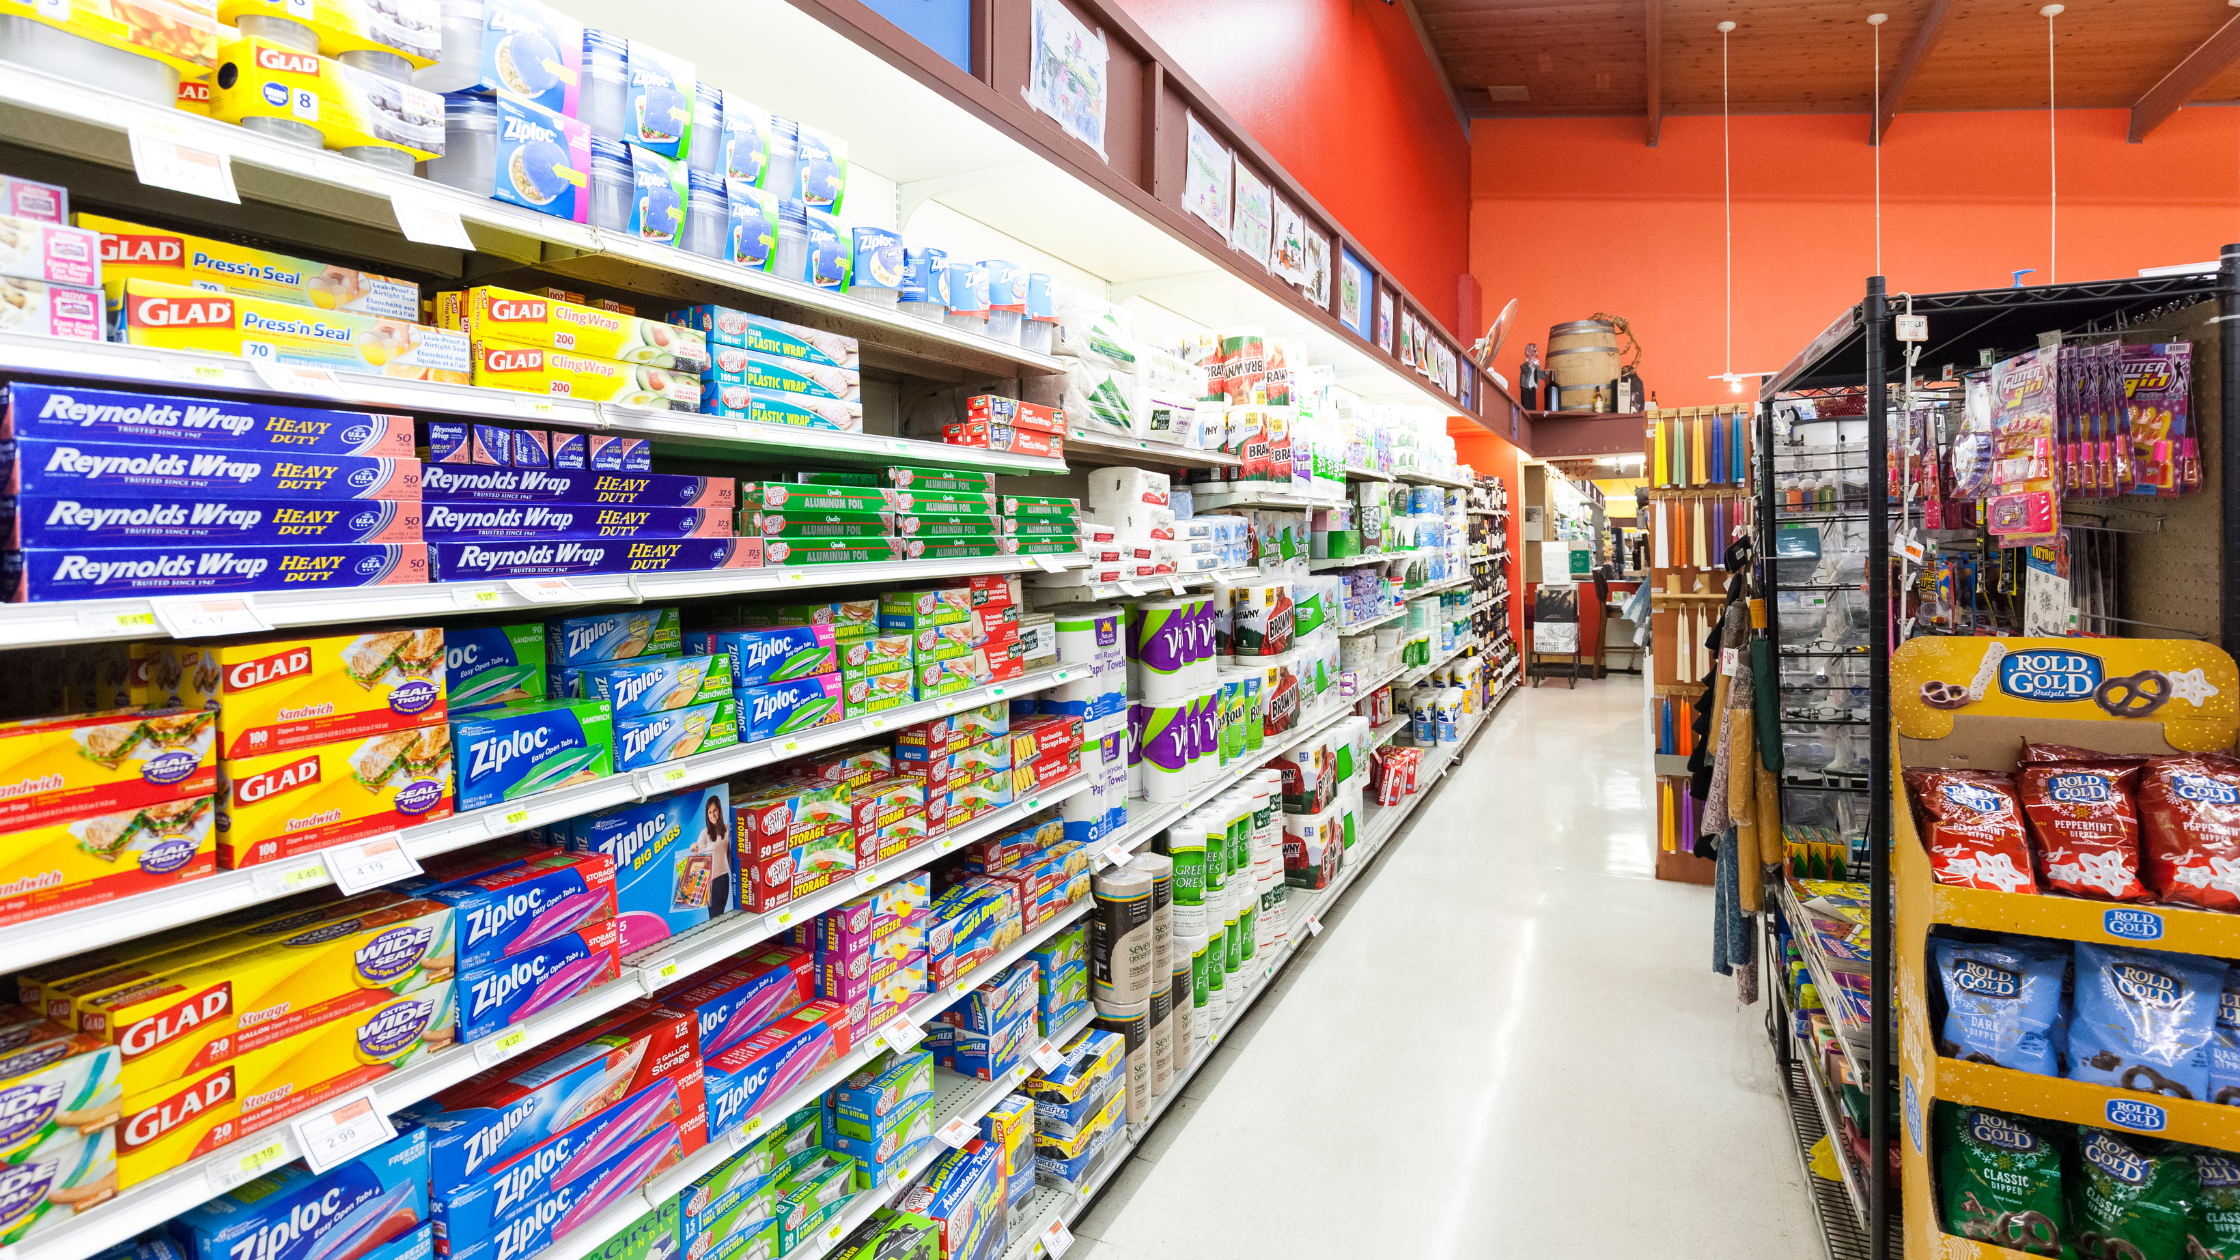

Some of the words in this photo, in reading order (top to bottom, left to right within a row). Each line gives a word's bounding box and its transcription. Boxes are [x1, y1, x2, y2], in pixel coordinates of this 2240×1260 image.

[299, 93, 312, 109] 8
[503, 116, 556, 144] Ziploc
[263, 266, 301, 286] Seal
[138, 298, 232, 326] GLAD
[244, 312, 310, 338] Press'n
[314, 325, 352, 341] Seal
[423, 334, 459, 346] Leak-Proof
[424, 341, 450, 352] Airtight
[748, 336, 780, 354] PLASTIC
[782, 343, 806, 359] WRAP
[250, 344, 268, 357] 70
[489, 350, 542, 371] GLAD
[748, 365, 761, 374] CLEAR
[2002, 366, 2044, 391] GLITTER
[2122, 362, 2168, 377] ITTER
[551, 382, 570, 395] 200
[748, 373, 780, 390] PLASTIC
[783, 379, 806, 393] WRAP
[2007, 375, 2044, 408] girl
[2124, 373, 2169, 398] girl
[38, 393, 181, 430] Reynolds
[752, 402, 765, 410] CLEAR
[752, 409, 784, 425] PLASTIC
[786, 413, 810, 427] WRAP
[1018, 432, 1031, 441] Clear
[44, 446, 189, 479] Reynolds
[403, 474, 419, 485] 50
[520, 471, 571, 496] Wrap
[594, 476, 651, 493] HEAVY
[598, 492, 640, 504] DUTY
[44, 500, 189, 533] Reynolds
[404, 516, 420, 527] 50
[523, 507, 573, 531] Wrap
[596, 510, 650, 527] HEAVY
[599, 525, 640, 537] DUTY
[801, 523, 843, 537] ALUMINUM
[555, 542, 605, 567] Wrap
[627, 543, 682, 560] HEAVY
[806, 550, 849, 562] ALUMINUM
[853, 549, 869, 561] FOIL
[54, 555, 194, 587] Reynolds
[196, 551, 269, 583] Wrap
[279, 555, 346, 573] HEAVY
[410, 558, 427, 569] 50
[630, 558, 671, 571] DUTY
[284, 570, 334, 583] DUTY
[477, 591, 493, 601] 5.27
[120, 614, 147, 625] 6.47
[1237, 608, 1260, 621] RAWNY
[1269, 608, 1293, 640] BRAWNY
[513, 635, 543, 644] SANDWICH
[747, 635, 793, 667] Ziploc
[229, 650, 309, 689] GLAD
[1106, 656, 1126, 671] Towels
[2016, 654, 2088, 674] ROLD
[697, 687, 732, 701] Sandwich
[2008, 672, 2094, 696] GOLD
[2033, 688, 2066, 699] Pretzels
[397, 692, 434, 705] TIGHT
[600, 704, 610, 713] 90
[753, 688, 800, 719] Ziploc
[1272, 685, 1297, 720] BRAWNY
[277, 702, 334, 722] Sandwich
[582, 712, 611, 724] SANDWICH
[249, 731, 268, 744] 100
[726, 723, 736, 732] XL
[622, 717, 670, 763] Ziploc
[704, 732, 738, 747] Sandwich
[141, 752, 203, 773] SEALS
[470, 726, 549, 780] Ziploc
[239, 758, 318, 803] GLAD
[2055, 775, 2100, 788] ROLD
[394, 781, 446, 804] SEALS
[402, 792, 439, 807] TIGHT
[2054, 785, 2106, 801] GOLD
[286, 809, 342, 832] Sandwich
[507, 812, 524, 823] 5.37
[878, 811, 905, 829] STORAGE
[2054, 819, 2113, 834] PEPPERMINT
[789, 825, 825, 849] STORAGE
[1953, 822, 2007, 838] PEPPERMINT
[2069, 829, 2100, 840] DIPPED
[139, 840, 201, 861] SEALS
[258, 842, 277, 857] 100
[634, 848, 656, 871] BIG
[655, 823, 682, 857] BAGS
[879, 839, 907, 860] STORAGE
[147, 851, 186, 866] TIGHT
[766, 855, 793, 878] WESTERN
[771, 868, 791, 888] FAMILY
[793, 874, 830, 899] STORAGE
[467, 887, 544, 946] Ziploc
[2111, 910, 2156, 926] ROLD
[378, 926, 412, 944] EXTRA
[2109, 920, 2160, 938] GOLD
[355, 926, 432, 965] WIDE
[373, 945, 415, 968] SEAL
[870, 962, 898, 986] FREEZER
[1965, 960, 2014, 983] ROLD
[2123, 965, 2174, 990] ROLD
[472, 954, 545, 1014] Ziploc
[1956, 973, 2015, 996] GOLD
[239, 1001, 290, 1029] Storage
[356, 998, 434, 1039] WIDE
[379, 1000, 412, 1018] EXTRA
[870, 1004, 899, 1031] FREEZER
[120, 990, 228, 1056] GLAD
[375, 1019, 416, 1044] SEAL
[676, 1023, 688, 1034] 12
[1970, 1015, 2000, 1032] DARK
[238, 1027, 270, 1041] GALLON
[504, 1034, 521, 1047] 4.37
[1969, 1027, 2000, 1042] DIPPED
[210, 1039, 229, 1055] 20
[651, 1050, 690, 1076] Storage
[241, 1083, 293, 1112] Storage
[715, 1066, 770, 1126] Ziploc
[124, 1074, 231, 1146] GLAD
[241, 1109, 272, 1125] GALLON
[2114, 1101, 2158, 1117] ROLD
[2110, 1112, 2161, 1129] GOLD
[213, 1123, 232, 1141] 20
[327, 1129, 356, 1149] 2.99
[412, 1131, 426, 1144] 38
[463, 1097, 535, 1177] Ziploc
[1973, 1127, 2033, 1150] GOLD
[252, 1147, 274, 1164] 3.19
[388, 1143, 427, 1167] FREEZER
[2084, 1145, 2143, 1183] GOLD
[494, 1138, 572, 1217] Ziploc
[942, 1166, 979, 1211] Advantage
[972, 1144, 995, 1167] Pack
[1983, 1168, 2030, 1189] CLASSIC
[1990, 1181, 2024, 1197] DIPPED
[716, 1193, 740, 1217] KITCHEN
[2086, 1186, 2123, 1218] CLASSIC
[800, 1213, 825, 1240] GARBAGE
